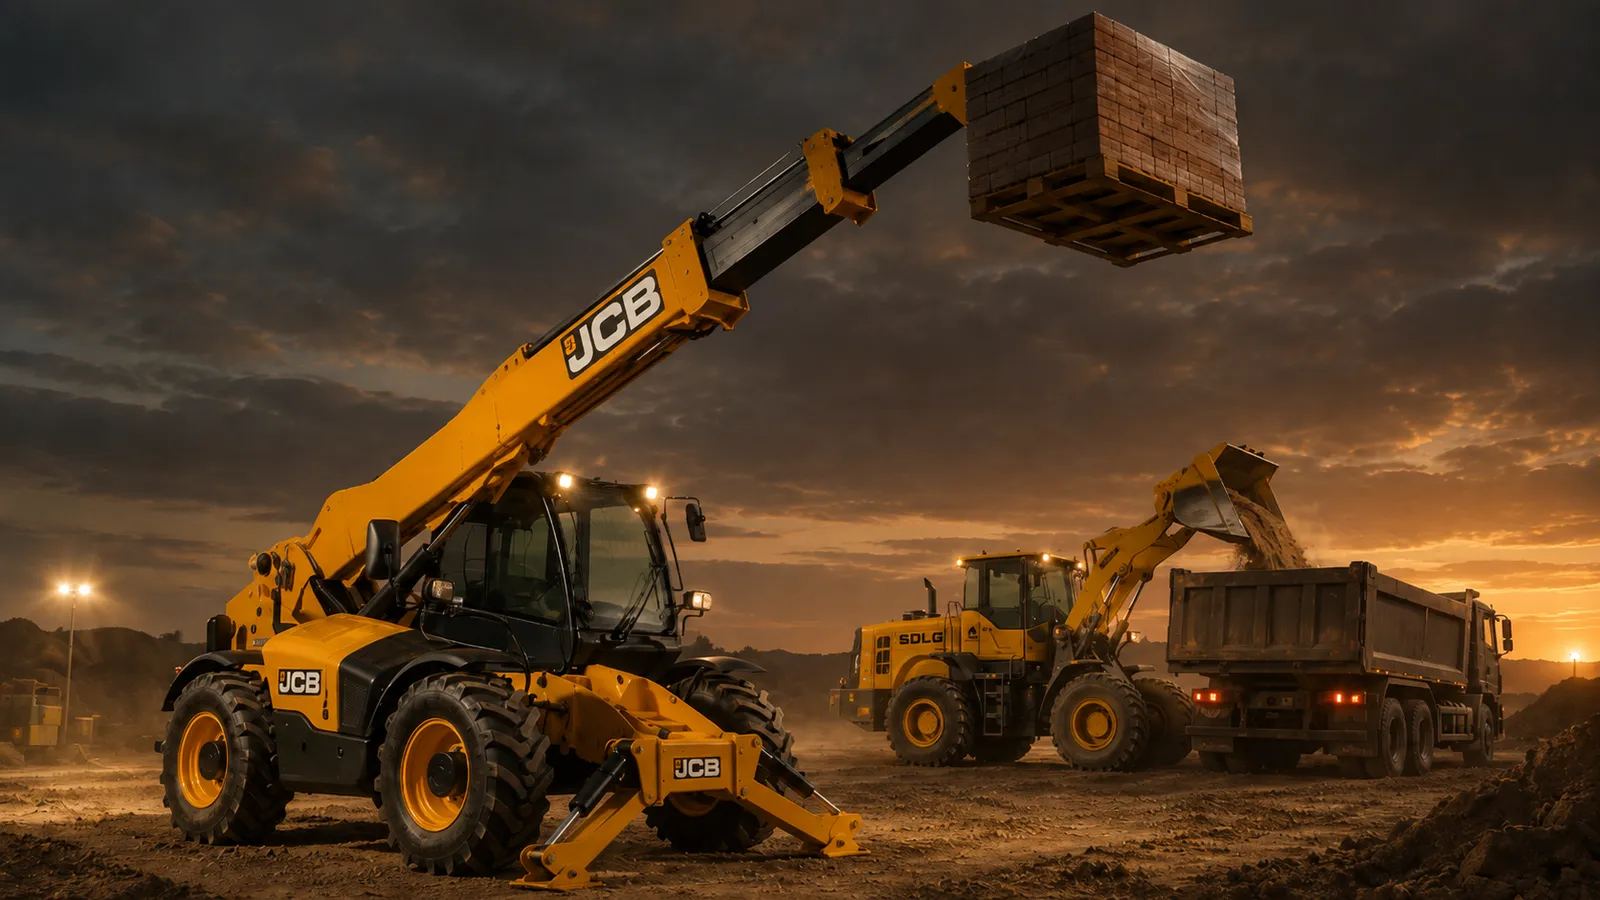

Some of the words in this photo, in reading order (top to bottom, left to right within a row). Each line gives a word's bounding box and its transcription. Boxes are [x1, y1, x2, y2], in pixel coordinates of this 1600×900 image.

[568, 276, 661, 373] JCB
[899, 632, 943, 645] SDLG
[279, 671, 320, 694] JCB
[675, 758, 720, 778] JCB
